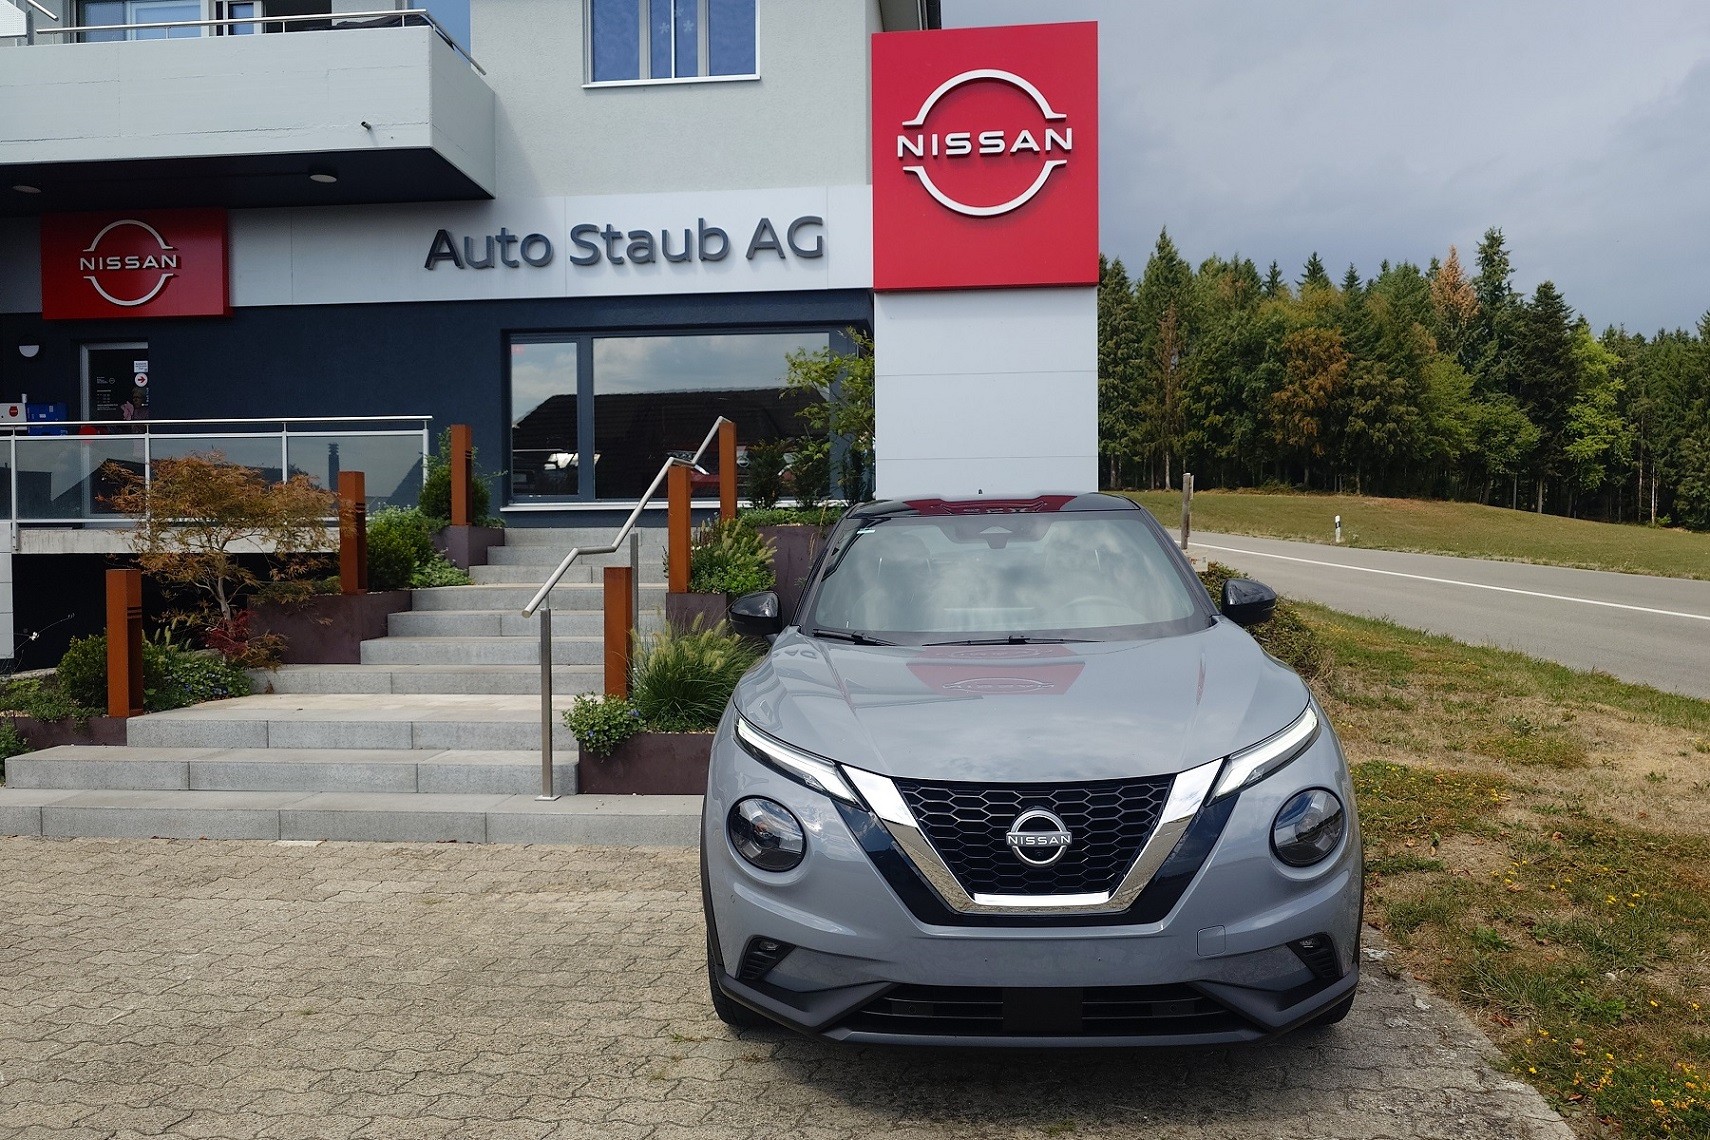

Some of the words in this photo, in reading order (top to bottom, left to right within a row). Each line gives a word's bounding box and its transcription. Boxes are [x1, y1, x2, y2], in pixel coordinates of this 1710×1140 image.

[897, 128, 1073, 158] NISSAN
[424, 227, 554, 271] Auto
[569, 217, 730, 265] Staub
[745, 215, 824, 260] AG
[80, 254, 177, 271] NISSAN
[1008, 835, 1071, 845] NISSAN
